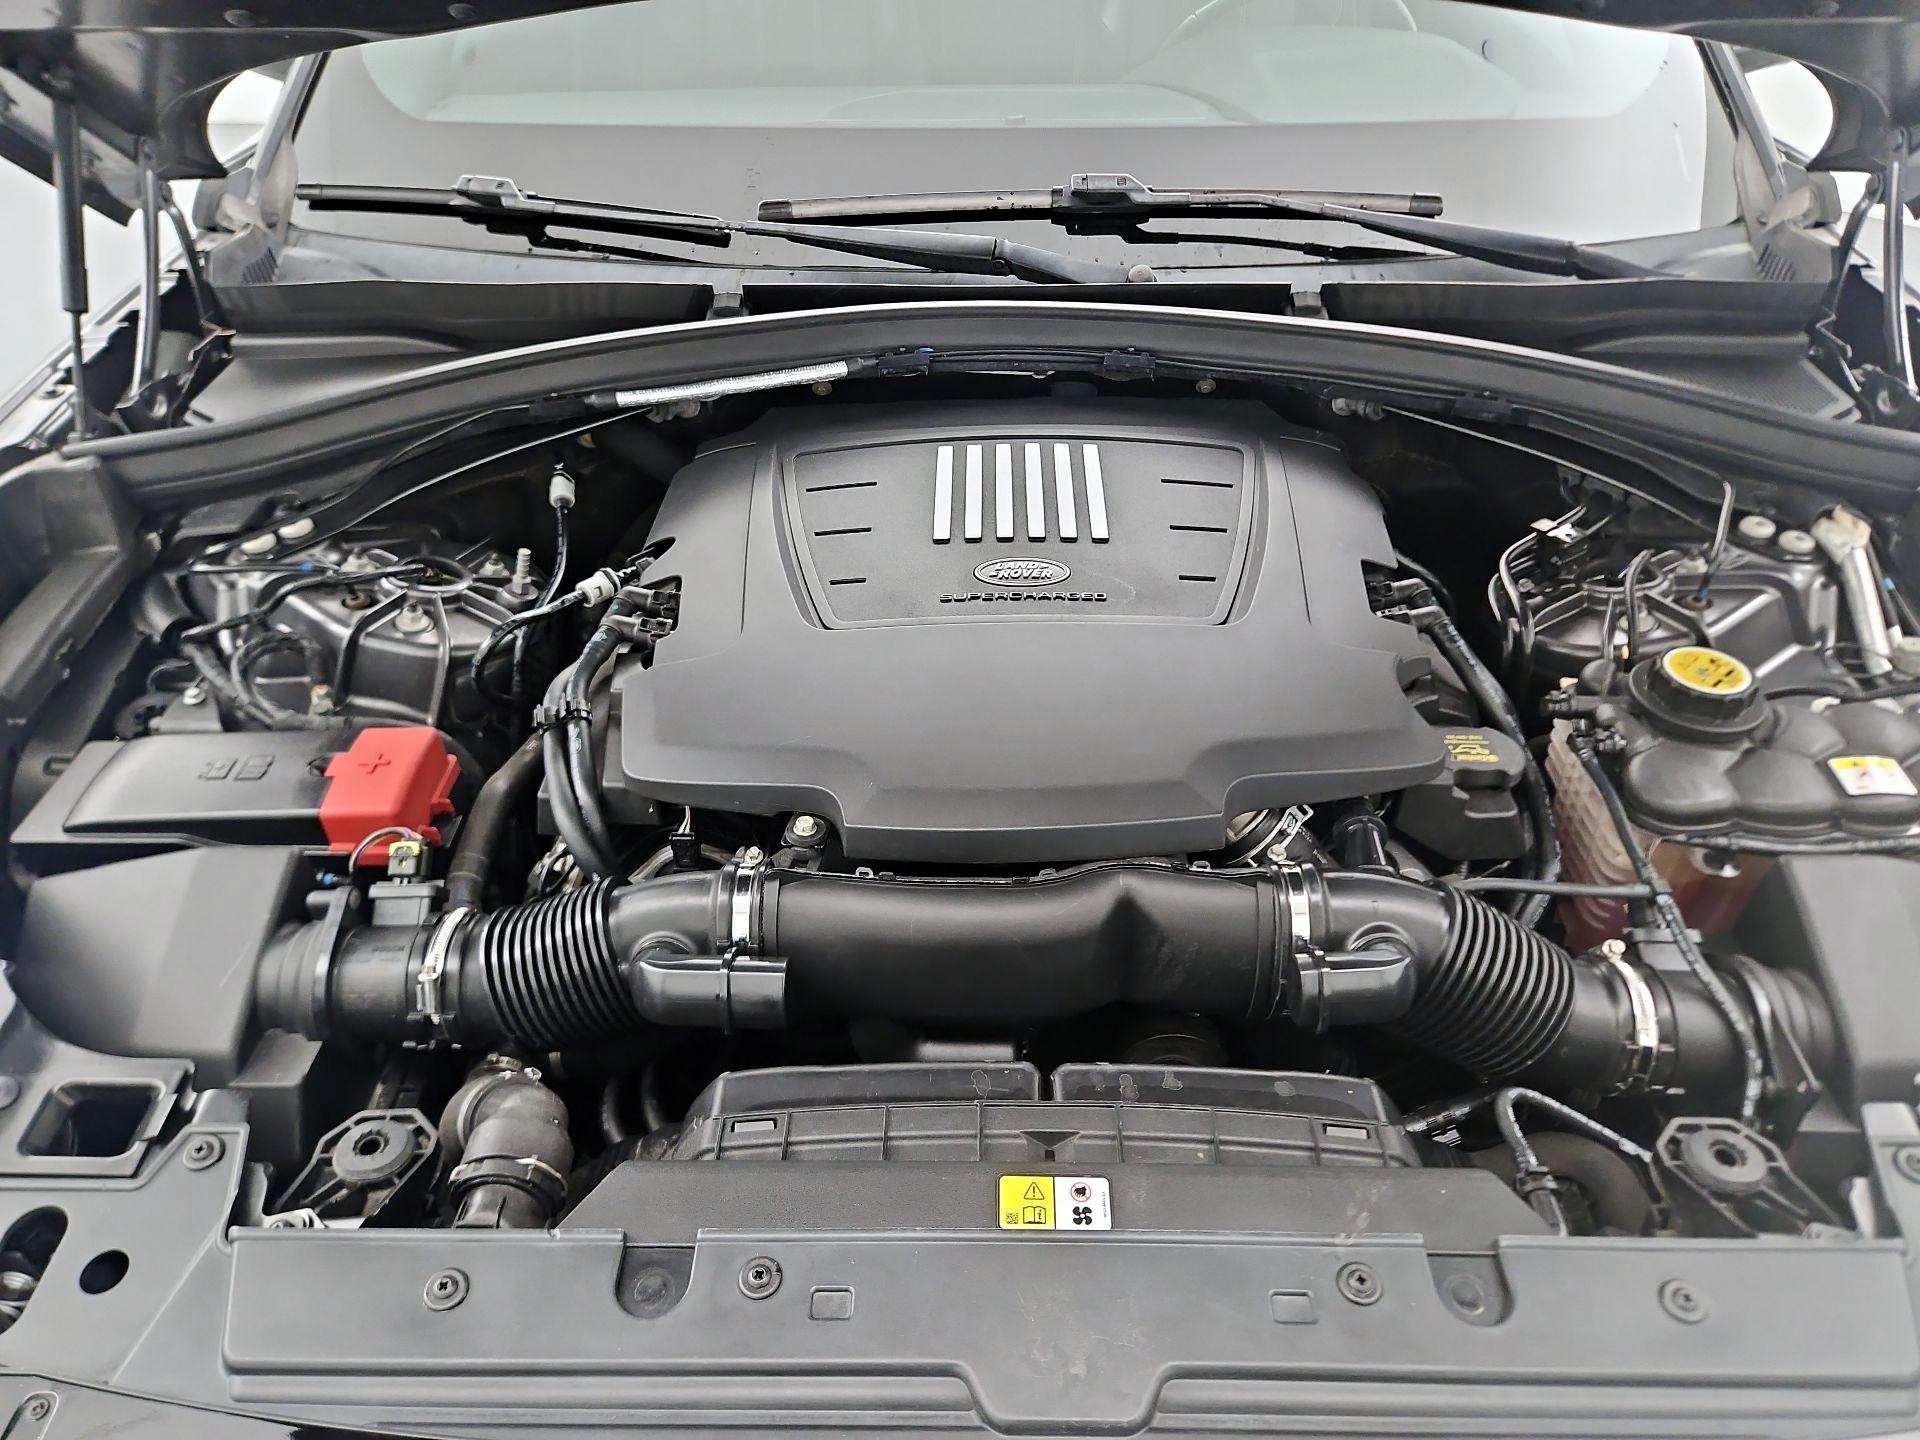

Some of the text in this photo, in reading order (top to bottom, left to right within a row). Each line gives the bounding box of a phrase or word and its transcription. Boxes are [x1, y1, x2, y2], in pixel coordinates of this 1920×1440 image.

[995, 561, 1041, 570] LAND
[998, 568, 1054, 580] ROVER
[939, 591, 1108, 603] SUPERCHARGED
